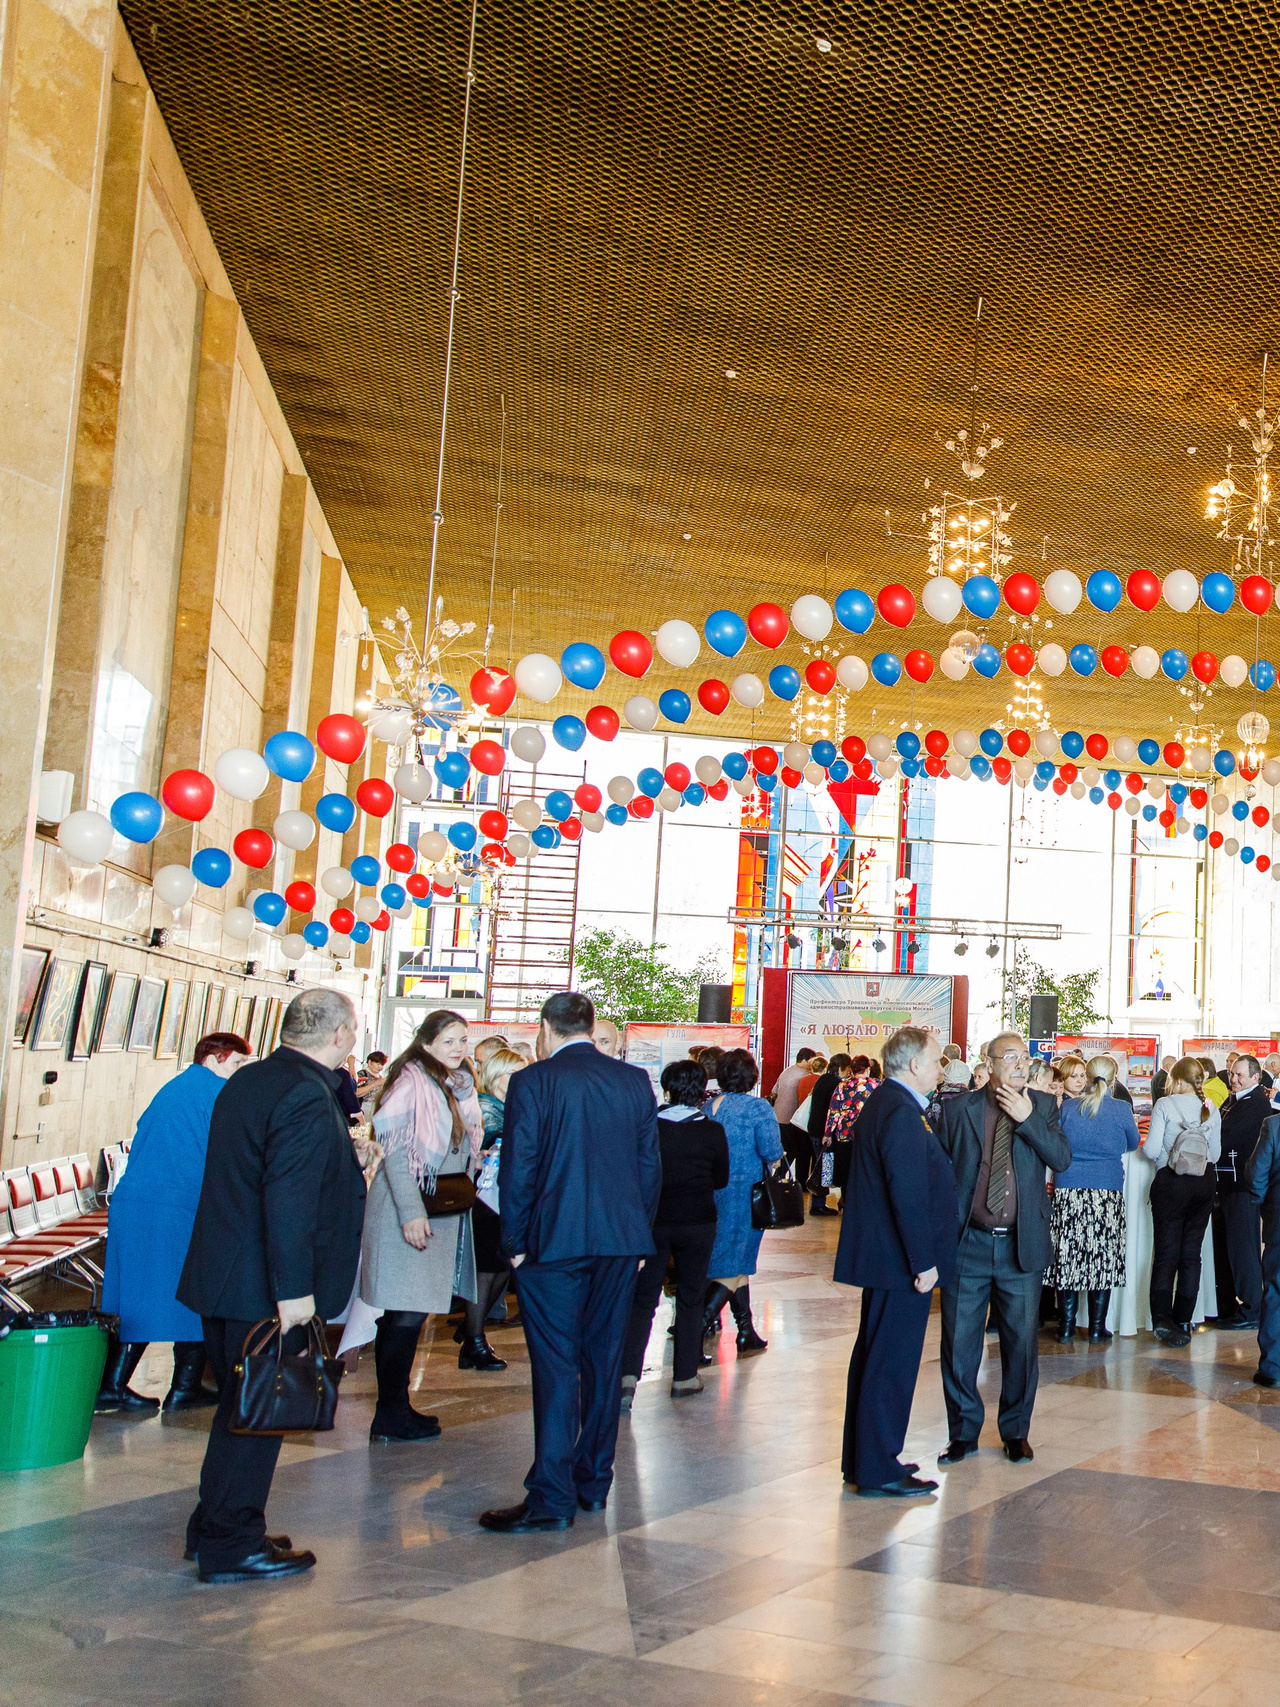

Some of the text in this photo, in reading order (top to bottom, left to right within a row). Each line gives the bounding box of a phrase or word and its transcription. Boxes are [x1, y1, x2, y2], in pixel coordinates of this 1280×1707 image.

[666, 1029, 686, 1038] ТУЛА
[800, 1024, 817, 1035] «Я
[822, 1024, 878, 1036] ЛЮБЛЮ
[1076, 1039, 1112, 1049] СМОЛЕНСК
[1201, 1042, 1237, 1051] МУРМАНСК
